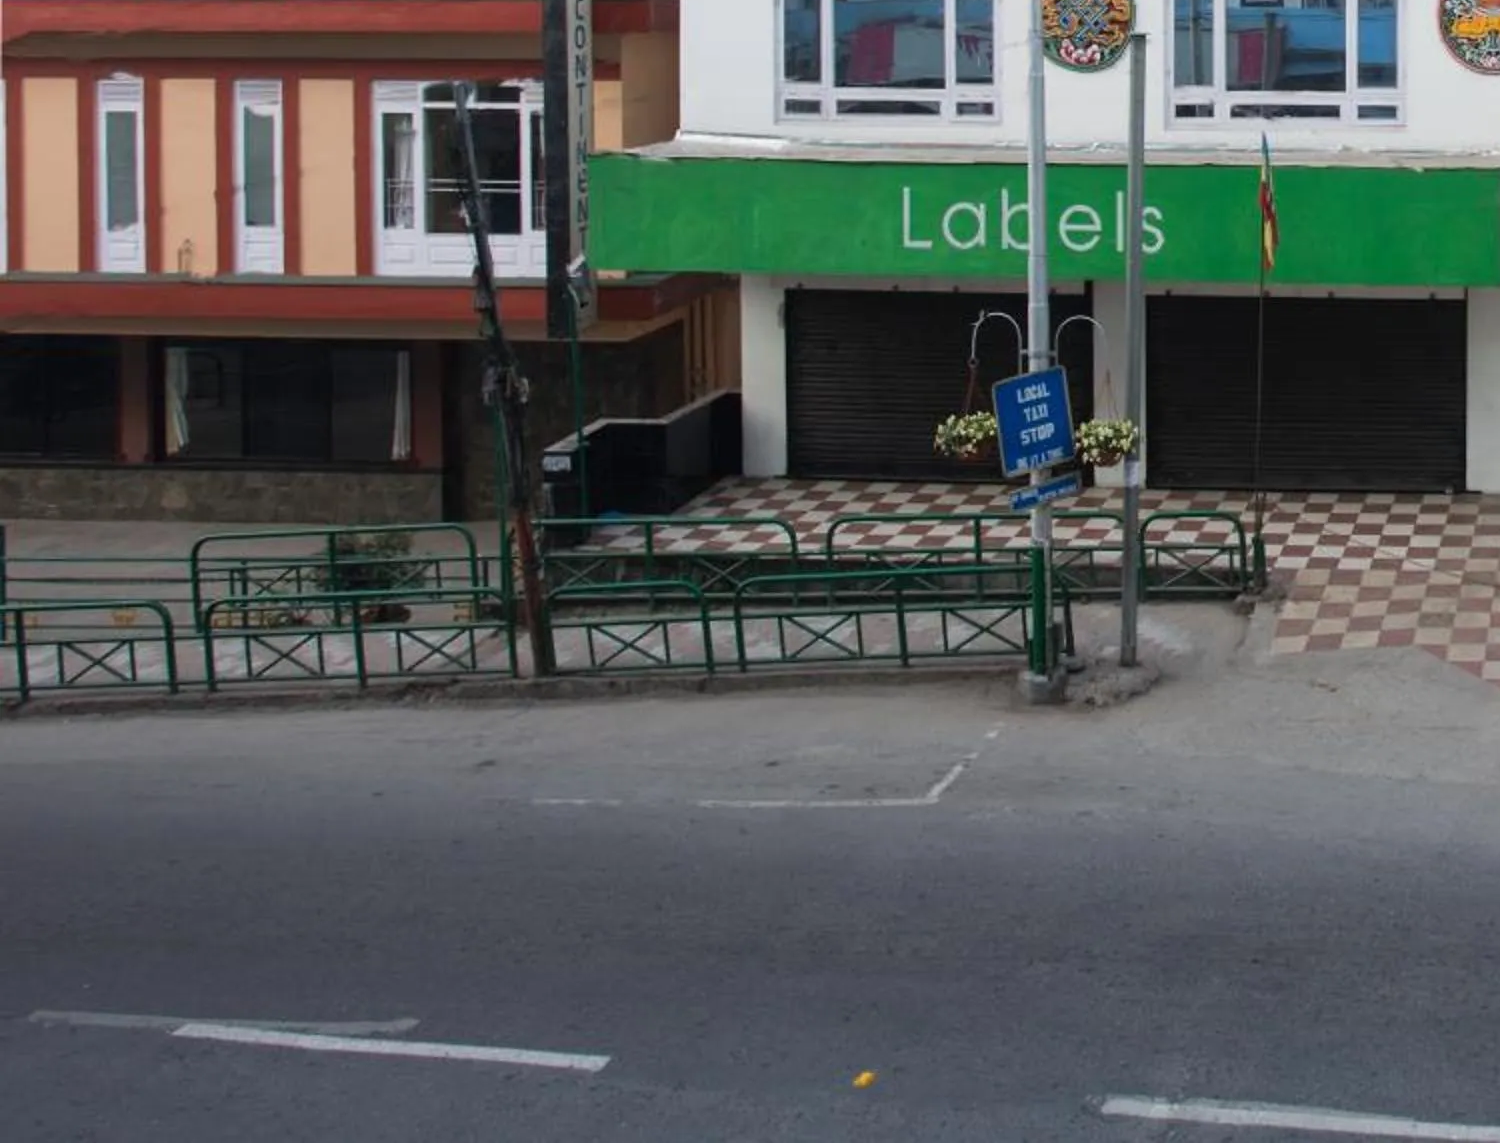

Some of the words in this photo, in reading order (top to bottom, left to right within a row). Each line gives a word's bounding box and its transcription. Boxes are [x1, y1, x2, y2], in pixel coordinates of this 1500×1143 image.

[903, 186, 1165, 254] Labels
[1024, 404, 1048, 422] TAXI
[1020, 423, 1054, 445] STOP
